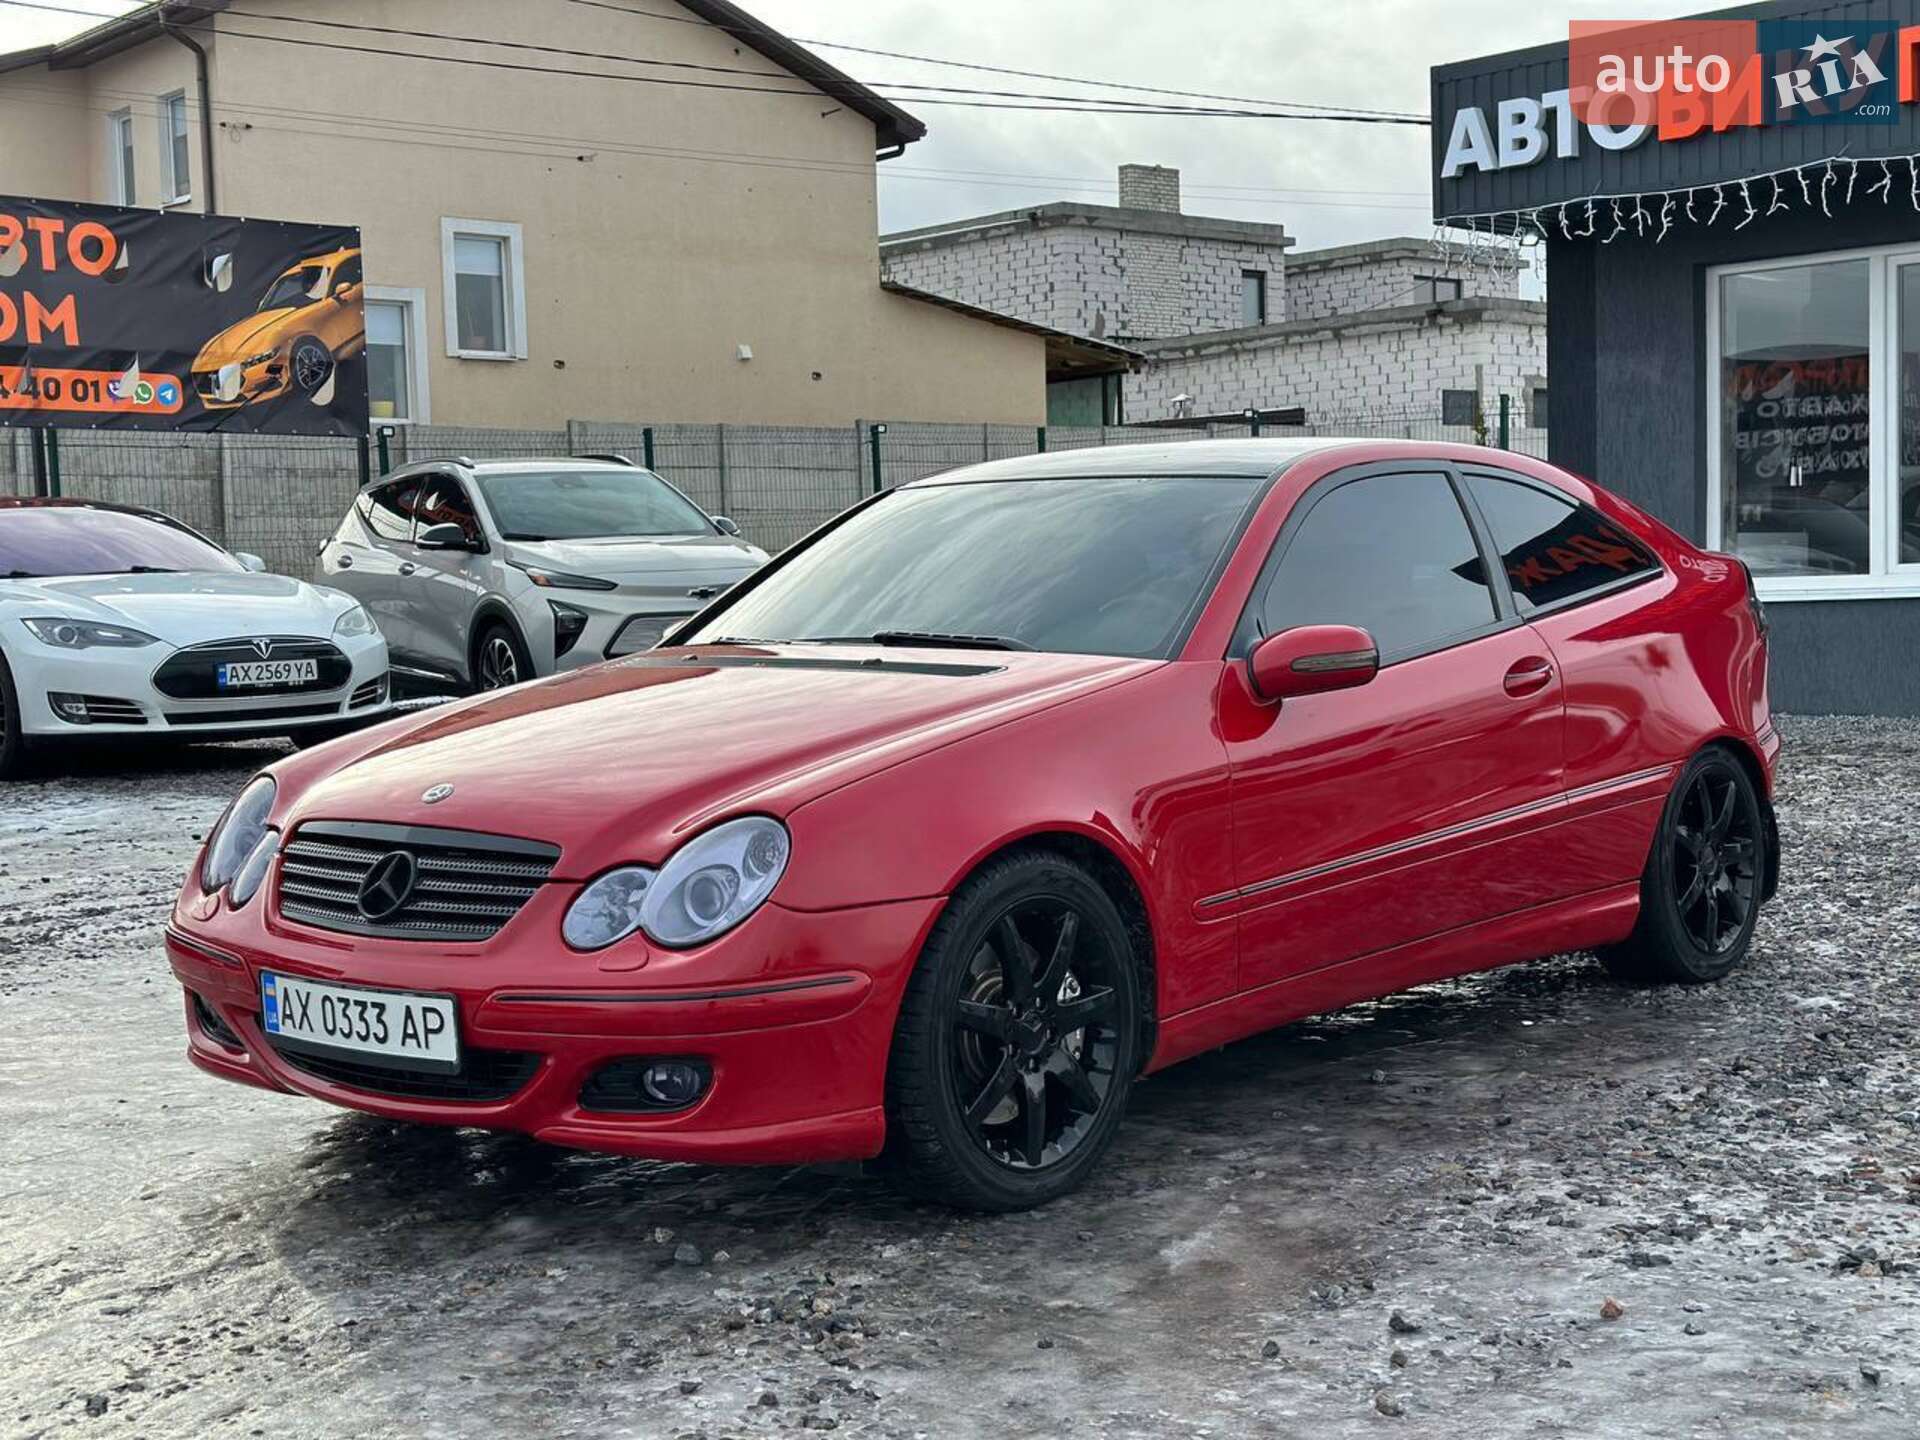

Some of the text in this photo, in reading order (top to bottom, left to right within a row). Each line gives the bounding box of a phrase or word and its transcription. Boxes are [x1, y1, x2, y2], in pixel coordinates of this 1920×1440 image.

[71, 378, 101, 403] 01
[229, 665, 252, 683] AX
[255, 662, 291, 681] 2569
[294, 661, 315, 679] YA
[281, 986, 445, 1050] AX 0333 AP
